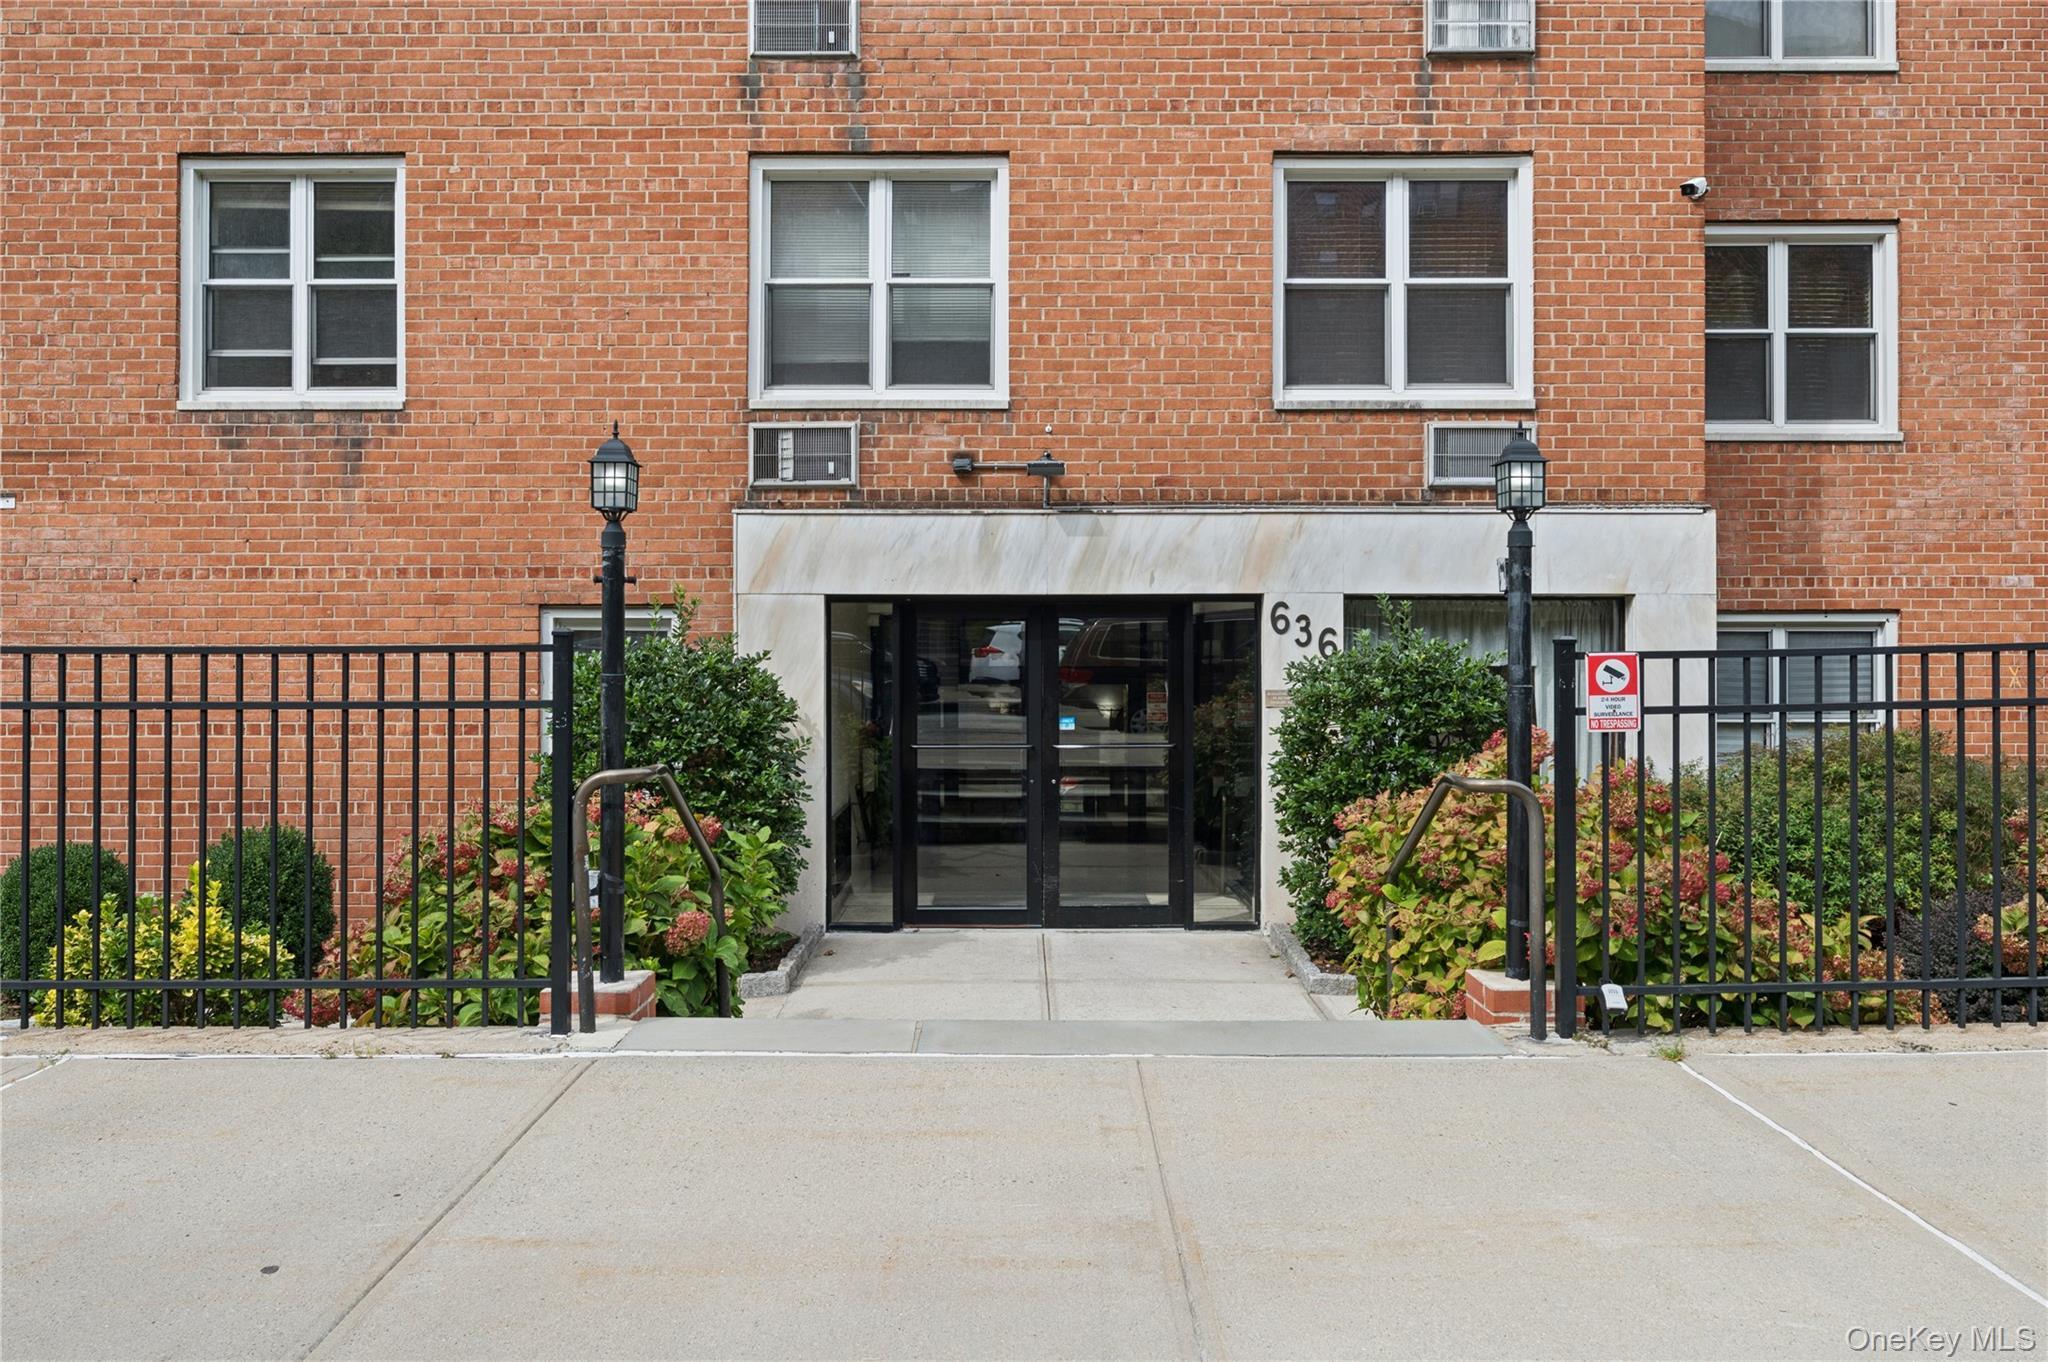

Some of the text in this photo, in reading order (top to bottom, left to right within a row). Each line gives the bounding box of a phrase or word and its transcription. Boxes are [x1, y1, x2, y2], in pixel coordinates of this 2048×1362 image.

[1270, 601, 1337, 660] 636
[1591, 719, 1637, 728] NO TRESPASSING
